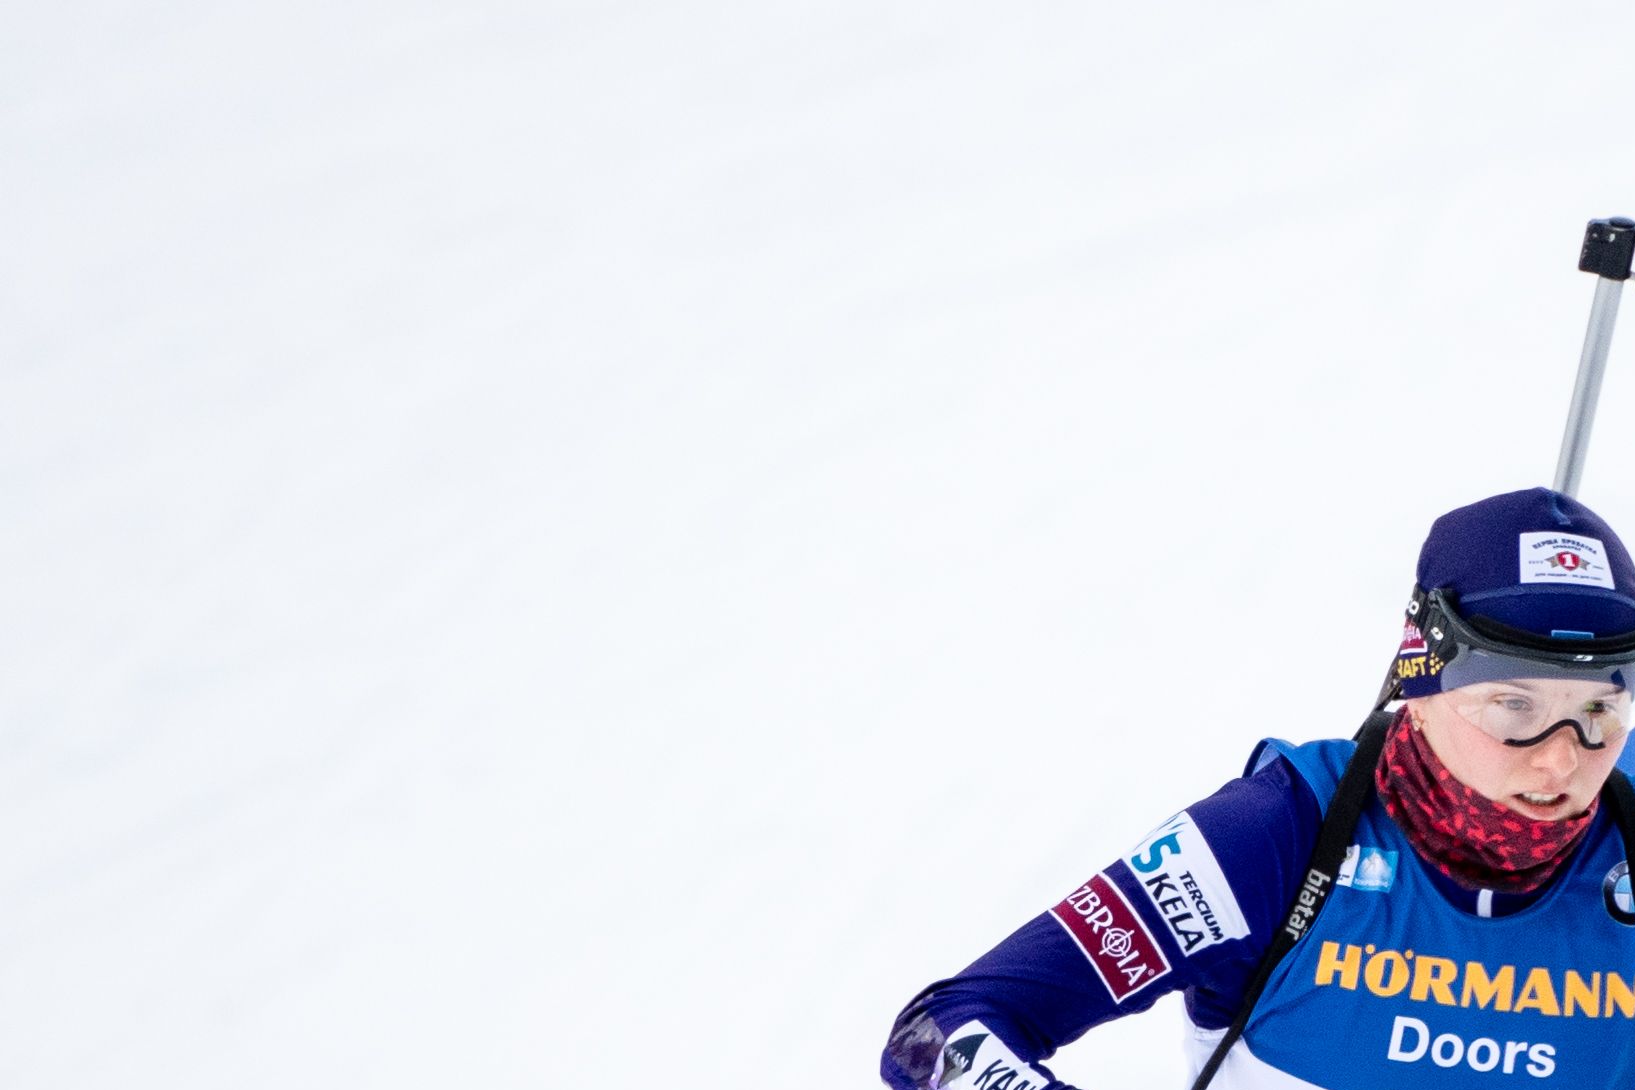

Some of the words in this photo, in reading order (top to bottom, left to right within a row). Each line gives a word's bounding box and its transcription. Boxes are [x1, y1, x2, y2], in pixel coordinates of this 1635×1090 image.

[1179, 870, 1224, 941] TERCIUM
[1286, 868, 1331, 941] biatar
[1387, 1015, 1556, 1078] Doors
